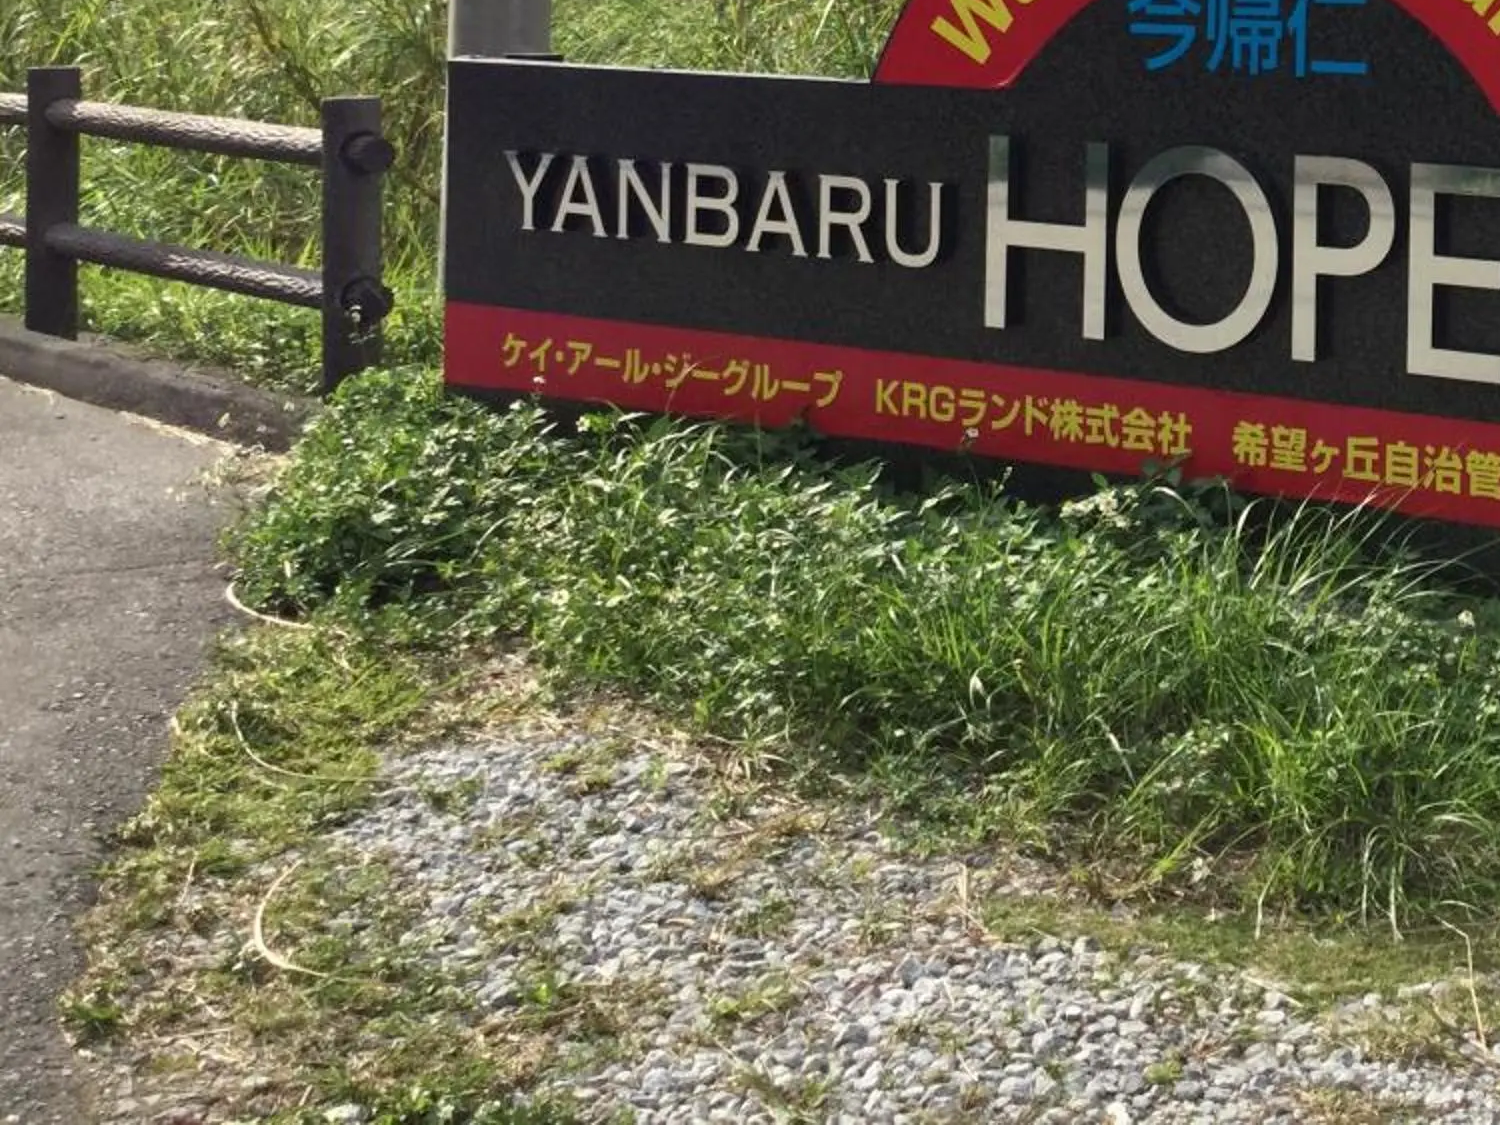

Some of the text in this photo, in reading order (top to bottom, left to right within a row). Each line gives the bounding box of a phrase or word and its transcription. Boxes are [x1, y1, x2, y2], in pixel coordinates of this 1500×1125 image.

[504, 150, 944, 267] YANBARU
[875, 379, 1192, 455] KRGランド株式会社
